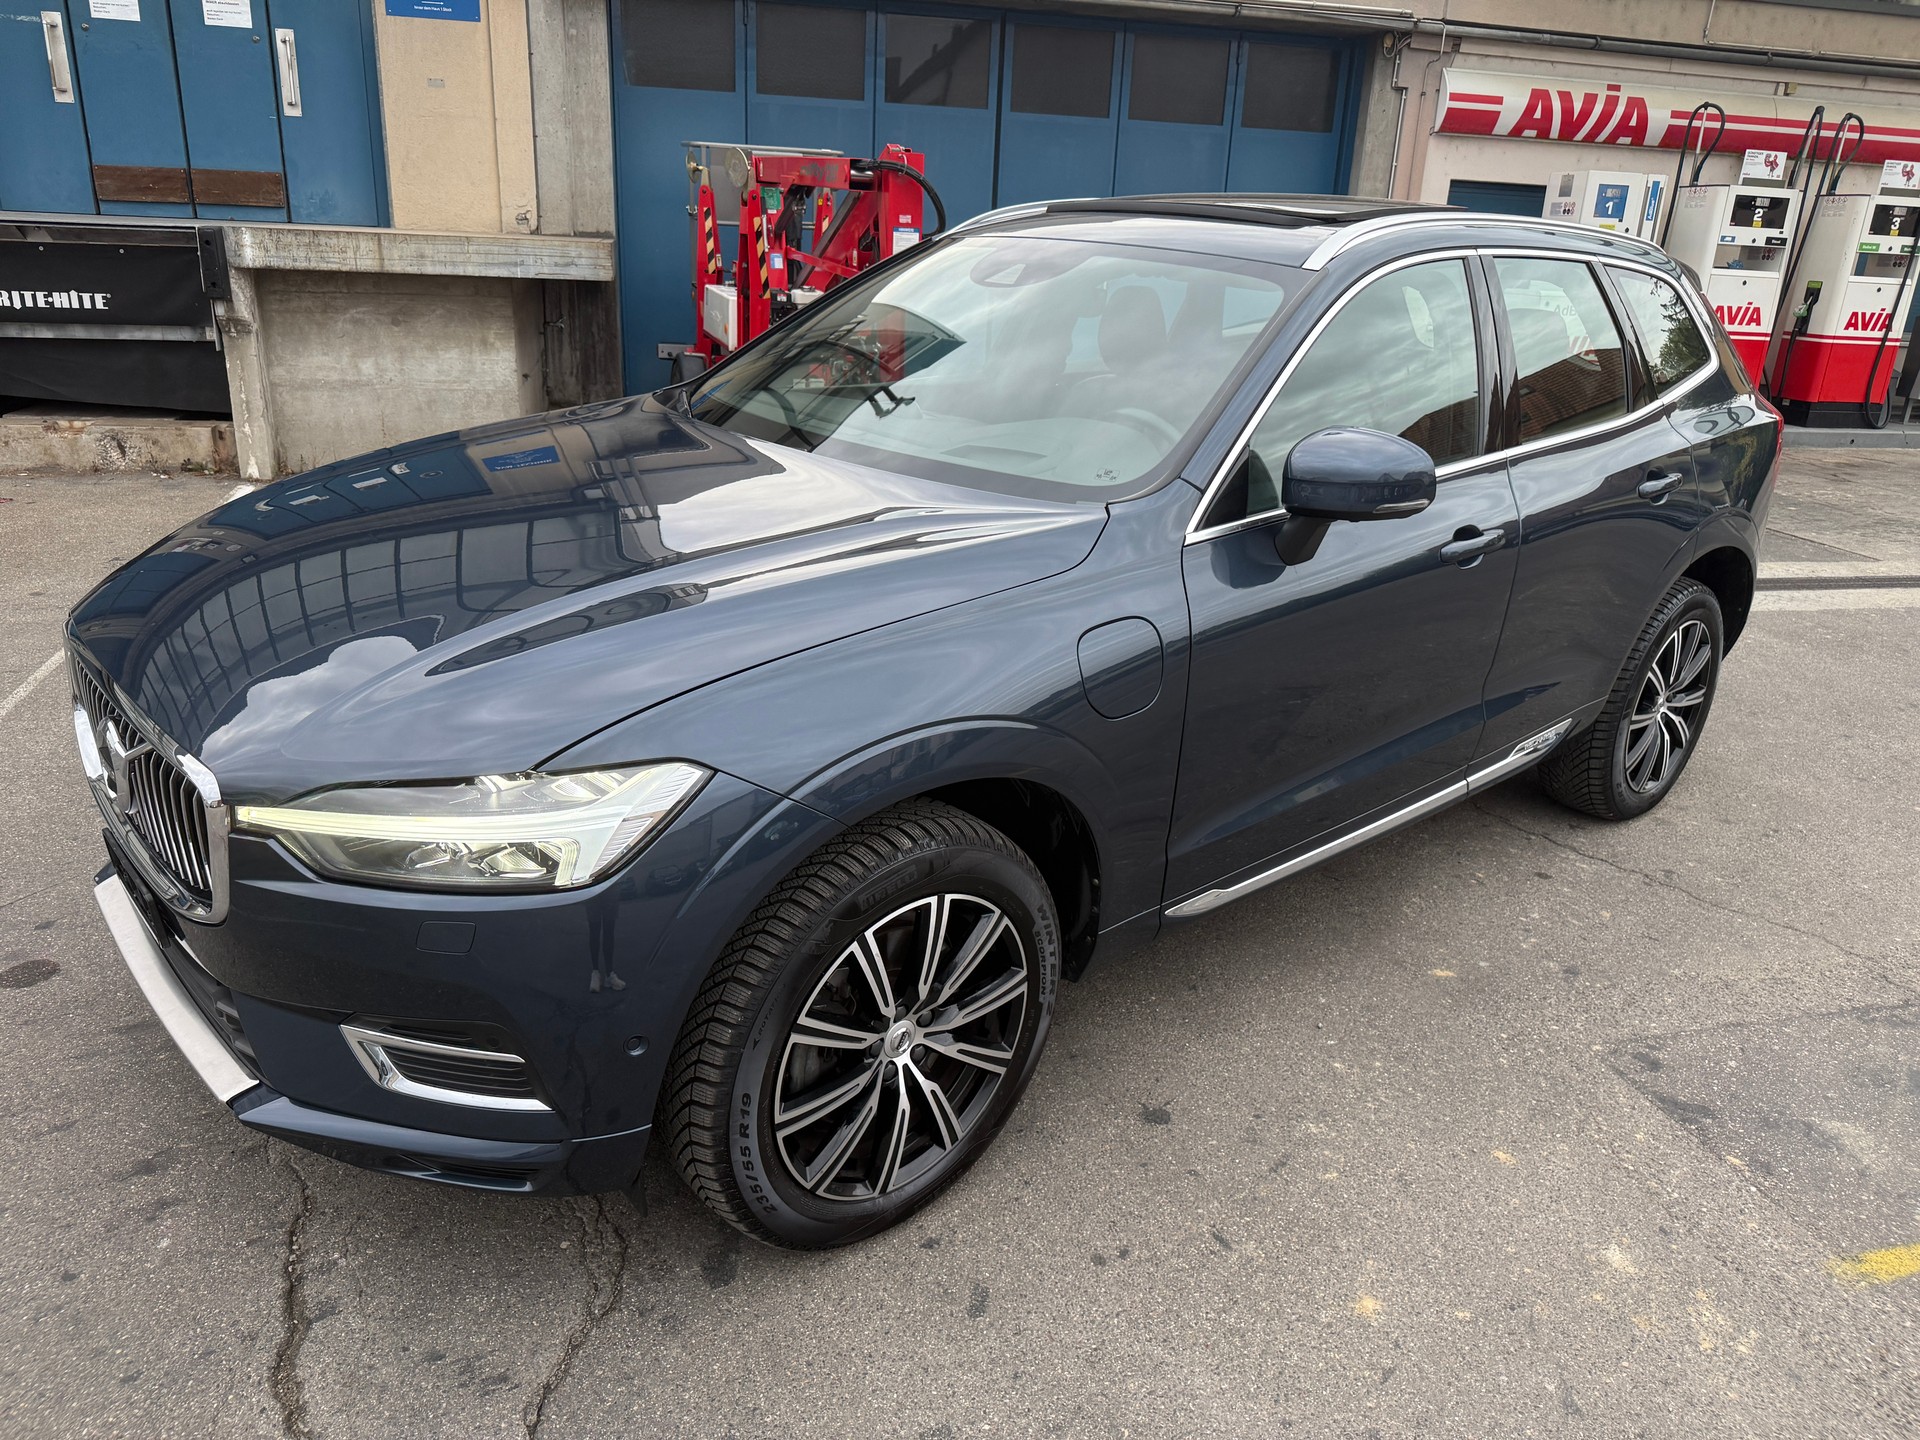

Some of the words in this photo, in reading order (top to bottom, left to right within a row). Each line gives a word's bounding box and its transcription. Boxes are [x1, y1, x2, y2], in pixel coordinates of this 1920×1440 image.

[1507, 84, 1648, 146] AVIA
[1605, 201, 1614, 215] 1
[1753, 208, 1763, 221] 2
[1891, 217, 1900, 230] 3
[1035, 931, 1048, 996] SCORPION
[1036, 904, 1057, 994] WINTER
[738, 1142, 778, 1213] 235/55
